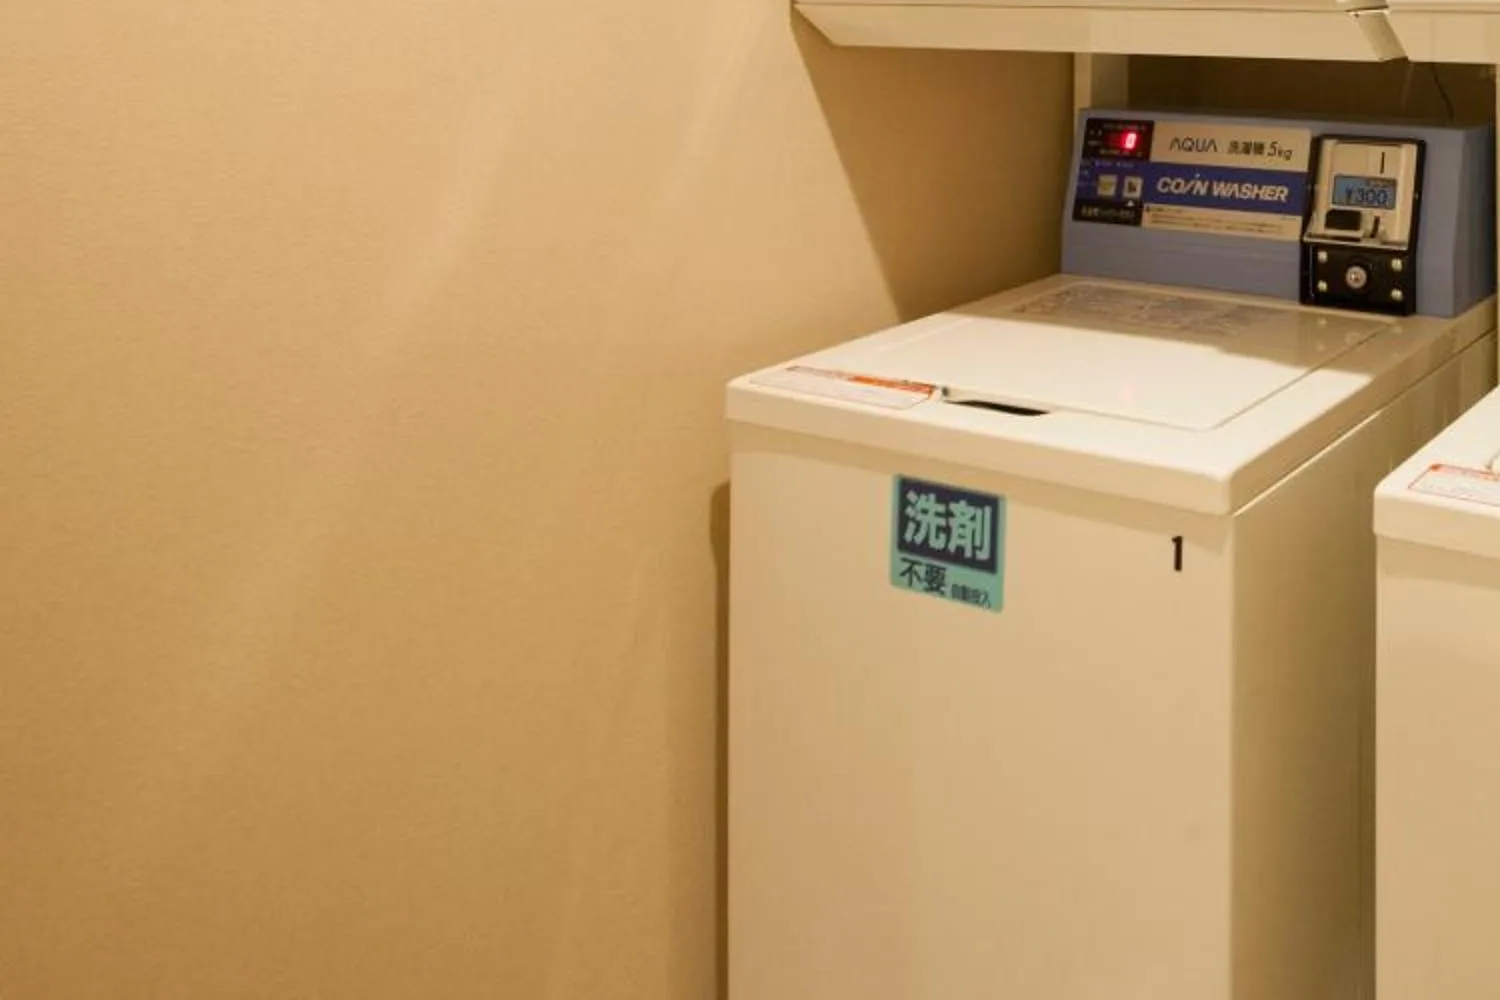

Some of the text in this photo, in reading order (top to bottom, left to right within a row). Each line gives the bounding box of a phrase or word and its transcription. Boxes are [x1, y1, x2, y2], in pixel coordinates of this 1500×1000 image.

[1123, 132, 1138, 150] 0
[1169, 136, 1218, 153] AQUA
[1212, 179, 1289, 203] WASHER
[904, 490, 992, 561] 洗剤
[1171, 535, 1183, 572] 1
[899, 557, 948, 596] 不要
